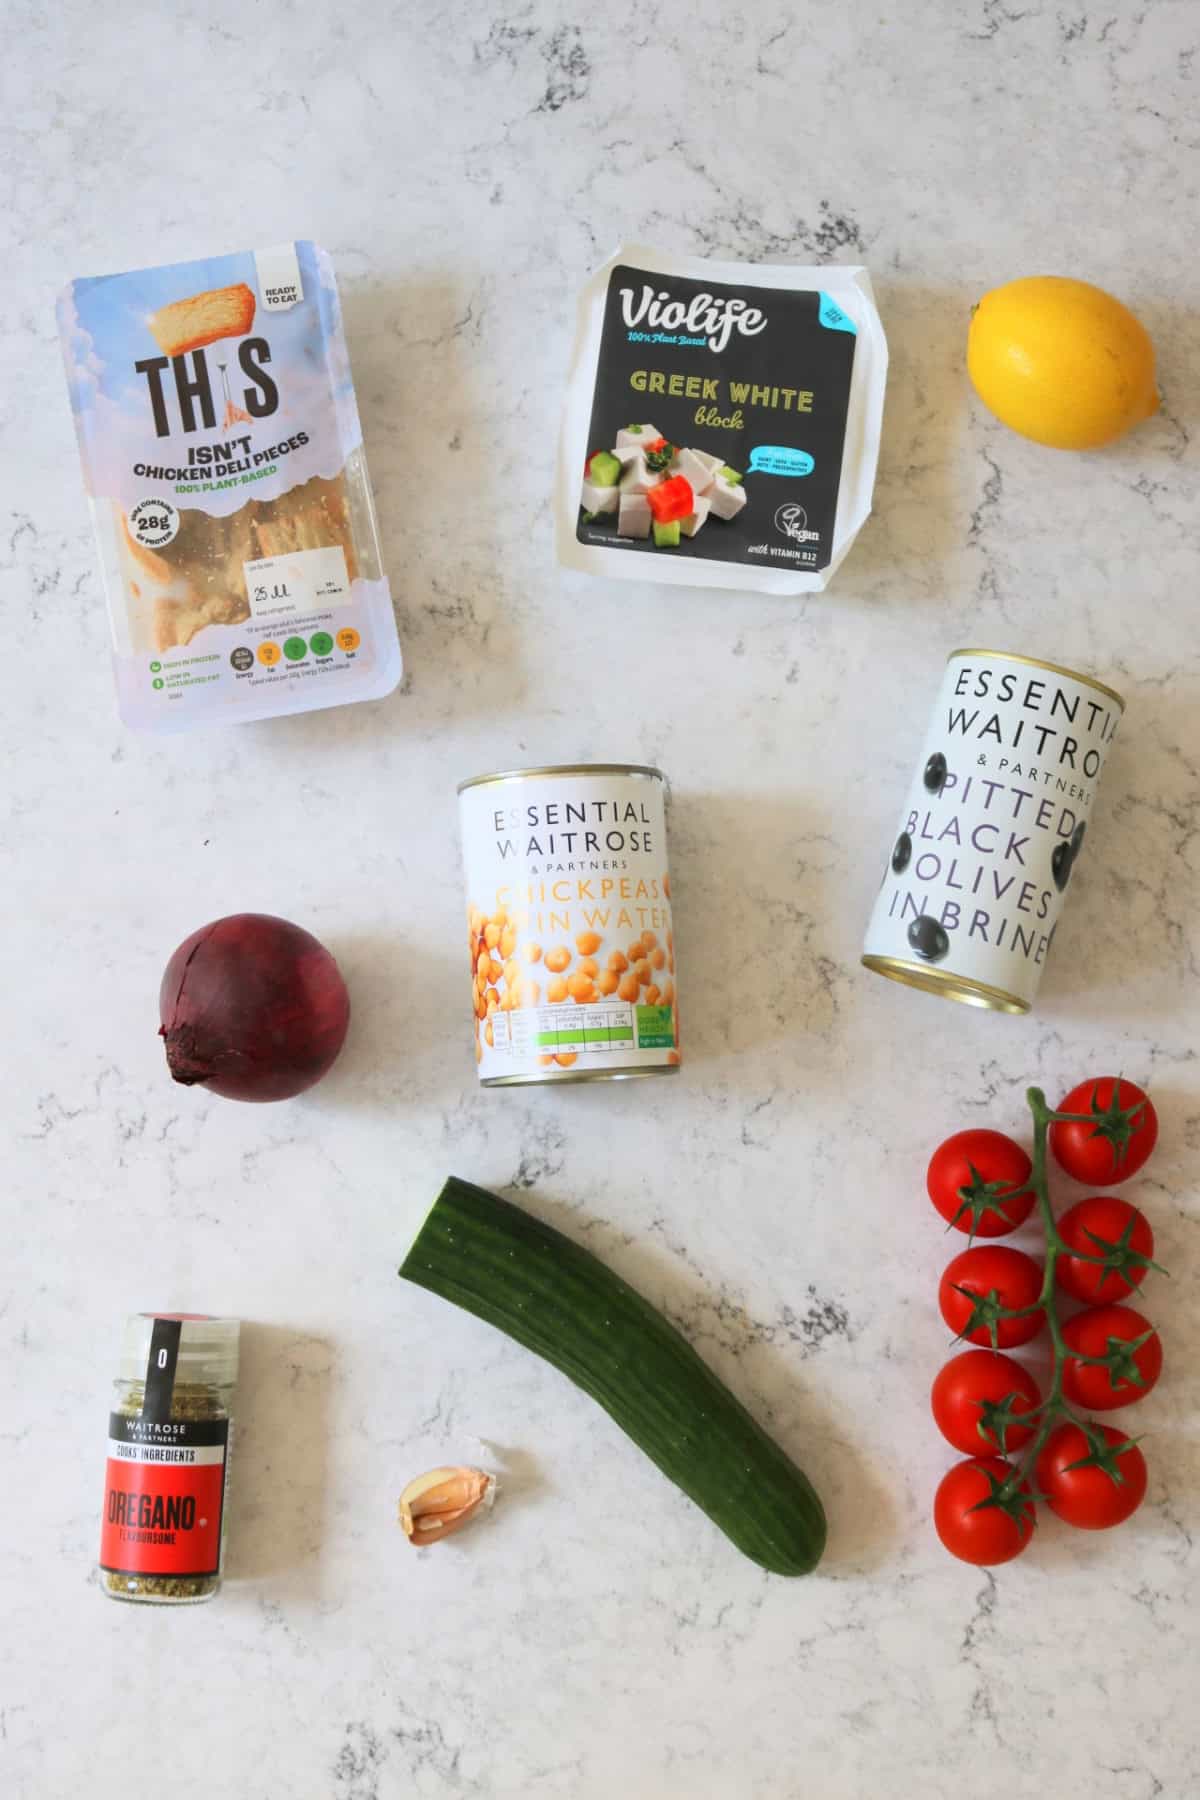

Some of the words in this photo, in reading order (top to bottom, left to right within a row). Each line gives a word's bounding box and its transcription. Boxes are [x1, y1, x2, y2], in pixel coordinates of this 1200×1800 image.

[265, 286, 297, 297] READY
[266, 295, 280, 305] TO
[281, 294, 298, 304] EAT
[619, 285, 768, 353] Violife
[651, 332, 677, 344] Plant
[678, 335, 707, 346] Based
[630, 370, 720, 400] GREEK
[729, 382, 815, 413] WHITE
[694, 406, 745, 429] block
[133, 463, 212, 481] CHICKEN
[215, 457, 250, 477] DELI
[253, 431, 309, 467] PIECES
[175, 483, 201, 494] 100%
[203, 465, 277, 492] PLANT-BASED
[137, 515, 170, 530] 28g
[781, 520, 820, 543] Vegan
[770, 547, 801, 559] VITAMIN
[802, 551, 817, 561] B12
[254, 586, 268, 601] 25
[948, 707, 1101, 778] WAITRO
[977, 753, 987, 766] &
[999, 758, 1091, 806] PARTNERS
[494, 801, 651, 831] ESSENTIAL
[938, 772, 1077, 839] PITTED
[497, 831, 653, 860] WAITROSE
[905, 810, 1031, 866] BLACK
[546, 860, 628, 873] PARTNERS
[914, 853, 1053, 920] OLIVES
[537, 910, 570, 934] IN
[889, 889, 929, 919] IN
[940, 900, 1048, 965] BRINE
[126, 1420, 186, 1434] WAITROSE
[139, 1435, 177, 1443] PARTNERS
[141, 1447, 195, 1462] INGREDIENTS
[107, 1489, 197, 1531] OREGANO
[119, 1528, 177, 1545] FLAVOURSOME
